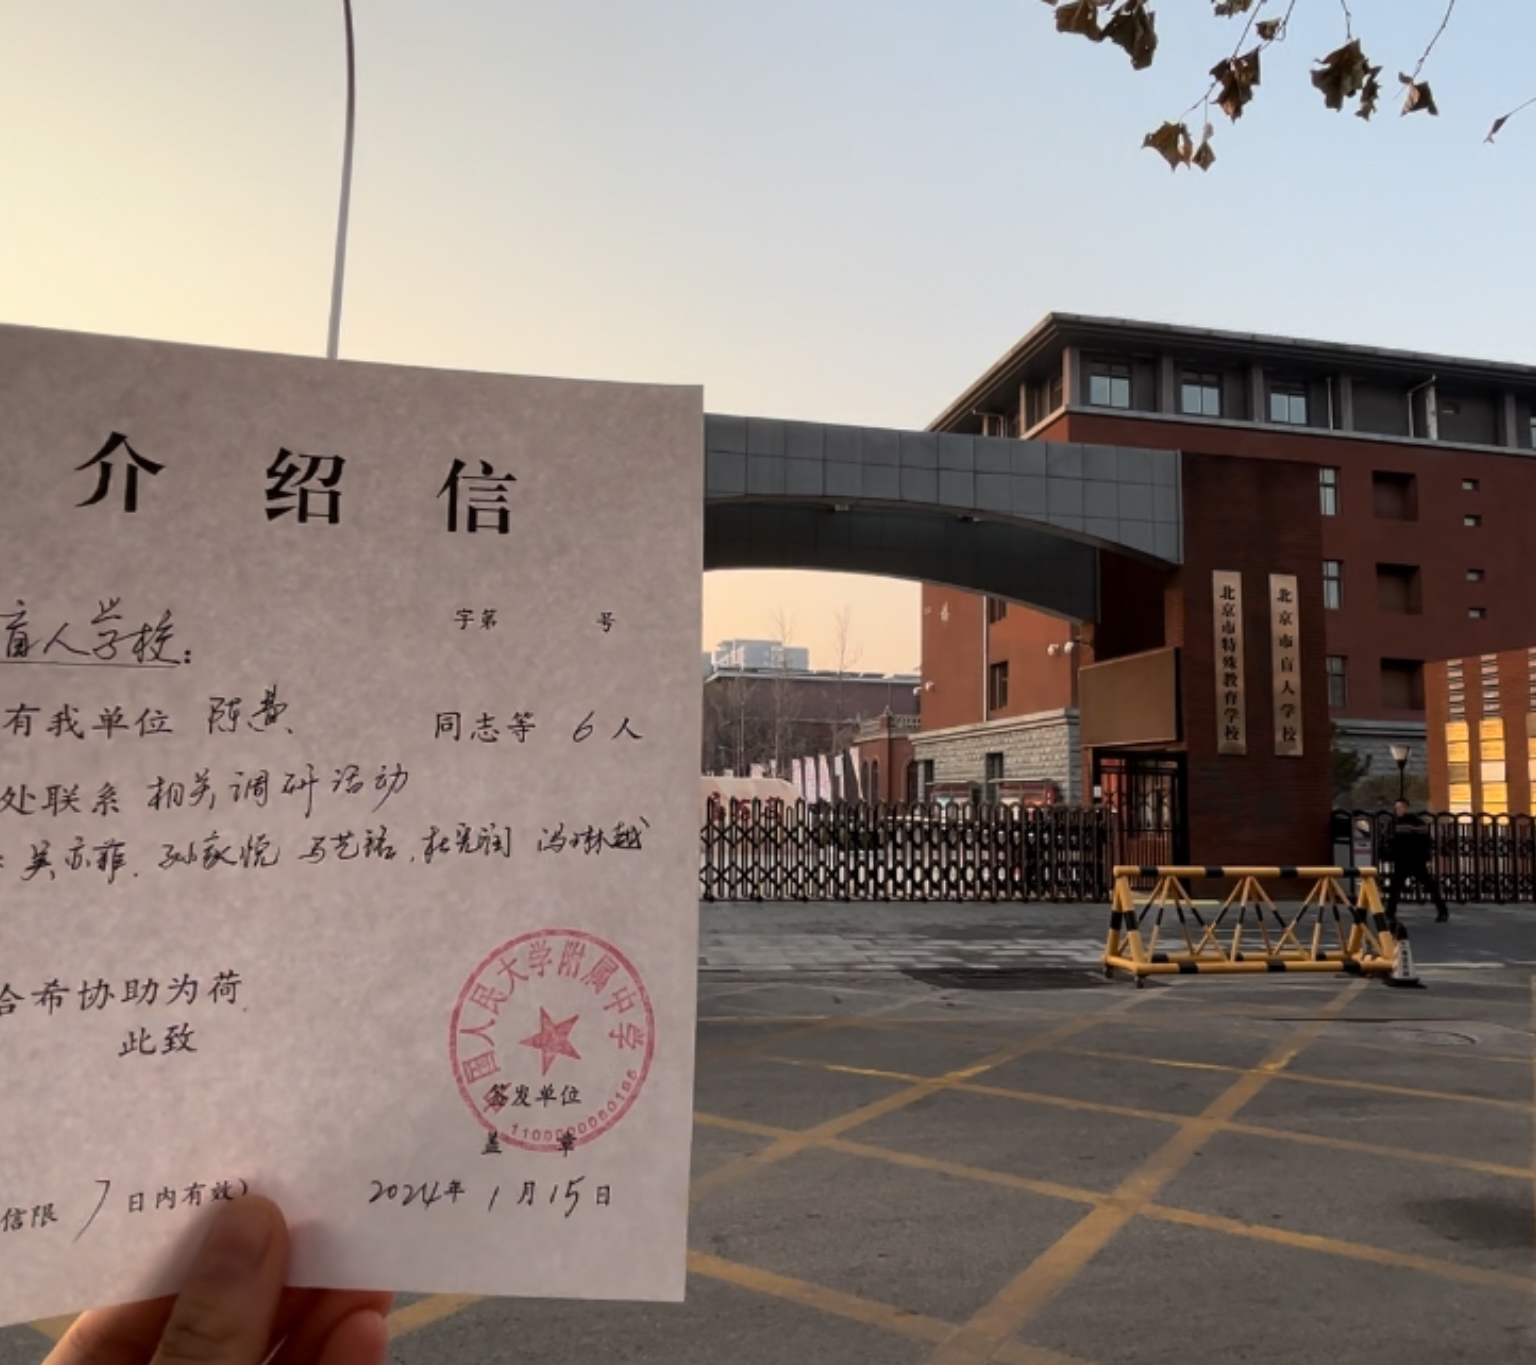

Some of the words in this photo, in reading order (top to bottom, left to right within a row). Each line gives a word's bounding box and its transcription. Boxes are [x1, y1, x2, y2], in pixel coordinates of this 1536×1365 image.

[75, 431, 517, 535] 介绍信
[454, 608, 497, 630] 字第
[597, 612, 616, 633] 号
[1220, 585, 1240, 741] 北京市特殊教育学校
[1277, 588, 1297, 743] 北京市盲人学校
[1, 703, 174, 739] 有我单位
[435, 711, 536, 743] 同志等
[572, 711, 595, 743] 6
[611, 717, 643, 740] 人
[0, 782, 120, 817] 处联系
[118, 1022, 198, 1057] 此致
[0, 1203, 58, 1232] 信限
